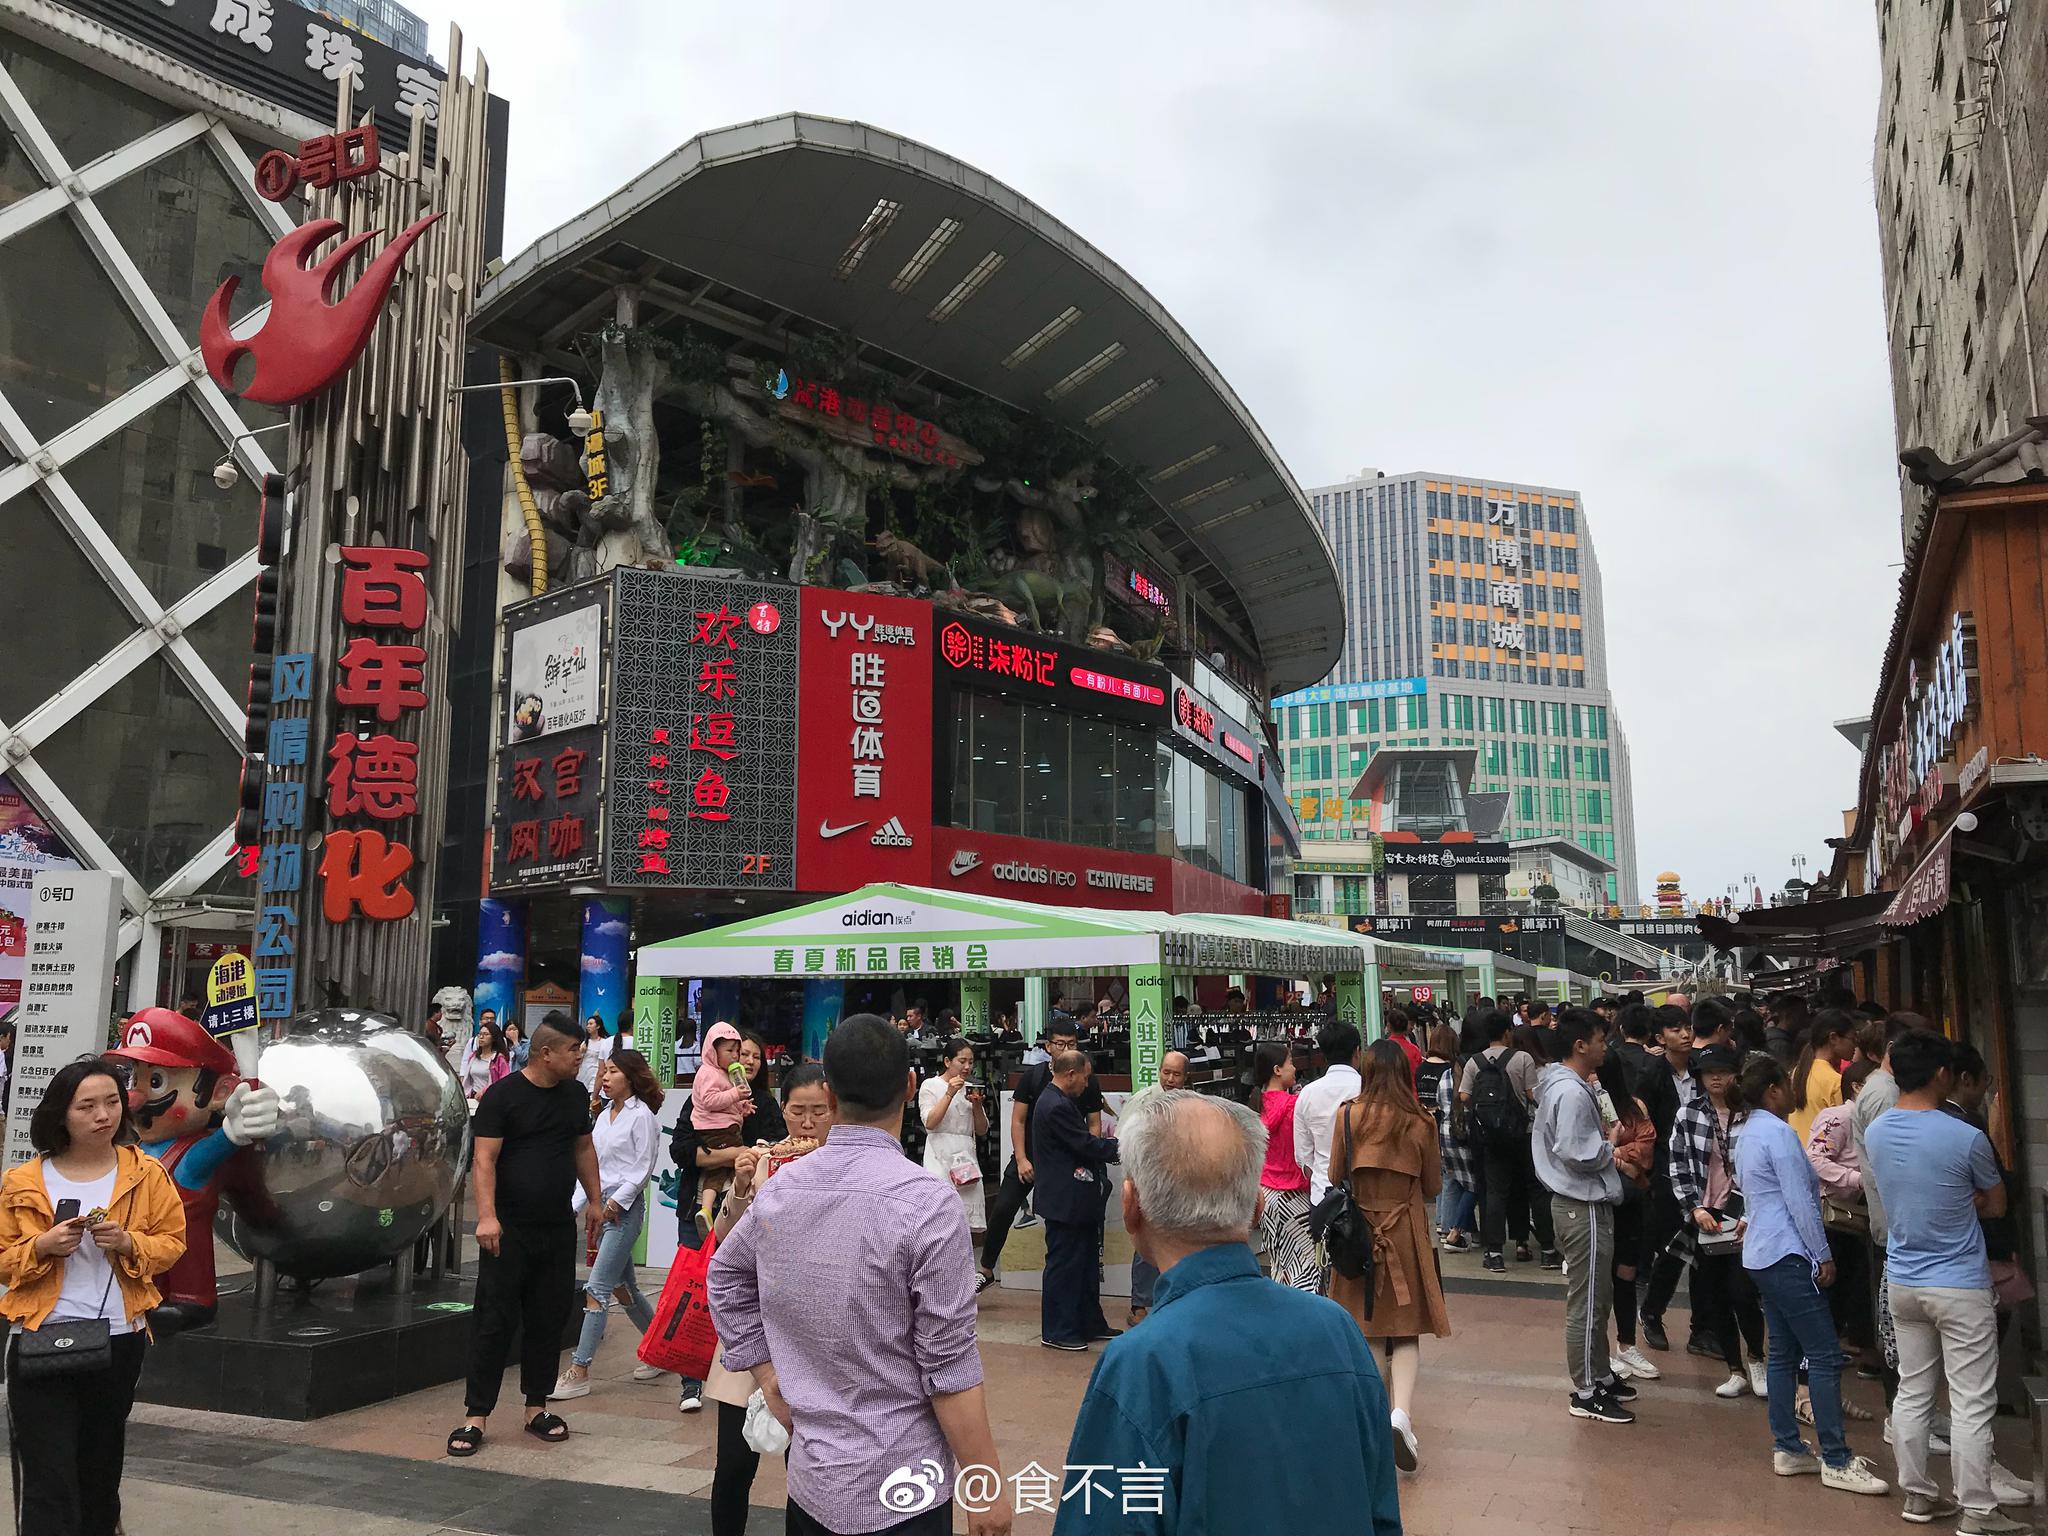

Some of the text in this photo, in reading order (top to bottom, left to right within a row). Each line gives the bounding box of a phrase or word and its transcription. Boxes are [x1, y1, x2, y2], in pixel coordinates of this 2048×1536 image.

[160, 0, 440, 128] 成珠宝
[588, 478, 608, 500] 3F
[1487, 498, 1526, 652] 万博商城
[821, 609, 875, 641] YY
[874, 624, 914, 637] 胜道体育
[872, 633, 916, 646] SPORTS
[988, 638, 1056, 687] 柒粉记
[688, 603, 743, 822] 欢乐逗鱼
[850, 652, 886, 798] 胜道体育
[319, 545, 432, 922] 百年德化
[511, 746, 587, 801] 汉宫
[1285, 795, 1371, 822] 客站 2F
[256, 653, 315, 1018] 风情购物公园
[507, 811, 585, 864] 网咖
[870, 833, 914, 847] adidas
[576, 857, 593, 875] 2F
[741, 855, 772, 876] 2F
[955, 850, 979, 865] NIKE
[993, 861, 1078, 887] adidas neo
[1087, 868, 1154, 893] CONVERSE
[842, 910, 894, 927] aidian
[1376, 917, 1411, 932] 潮掌门
[1522, 918, 1560, 932] 潮掌门
[773, 944, 988, 973] 春夏新品展销会
[214, 959, 247, 987] 海港
[215, 982, 248, 1003] 动漫城
[1414, 988, 1431, 1001] 69
[207, 1004, 256, 1029] 请上三楼
[659, 1007, 673, 1083] 全场5折
[13, 1129, 32, 1139] Tao
